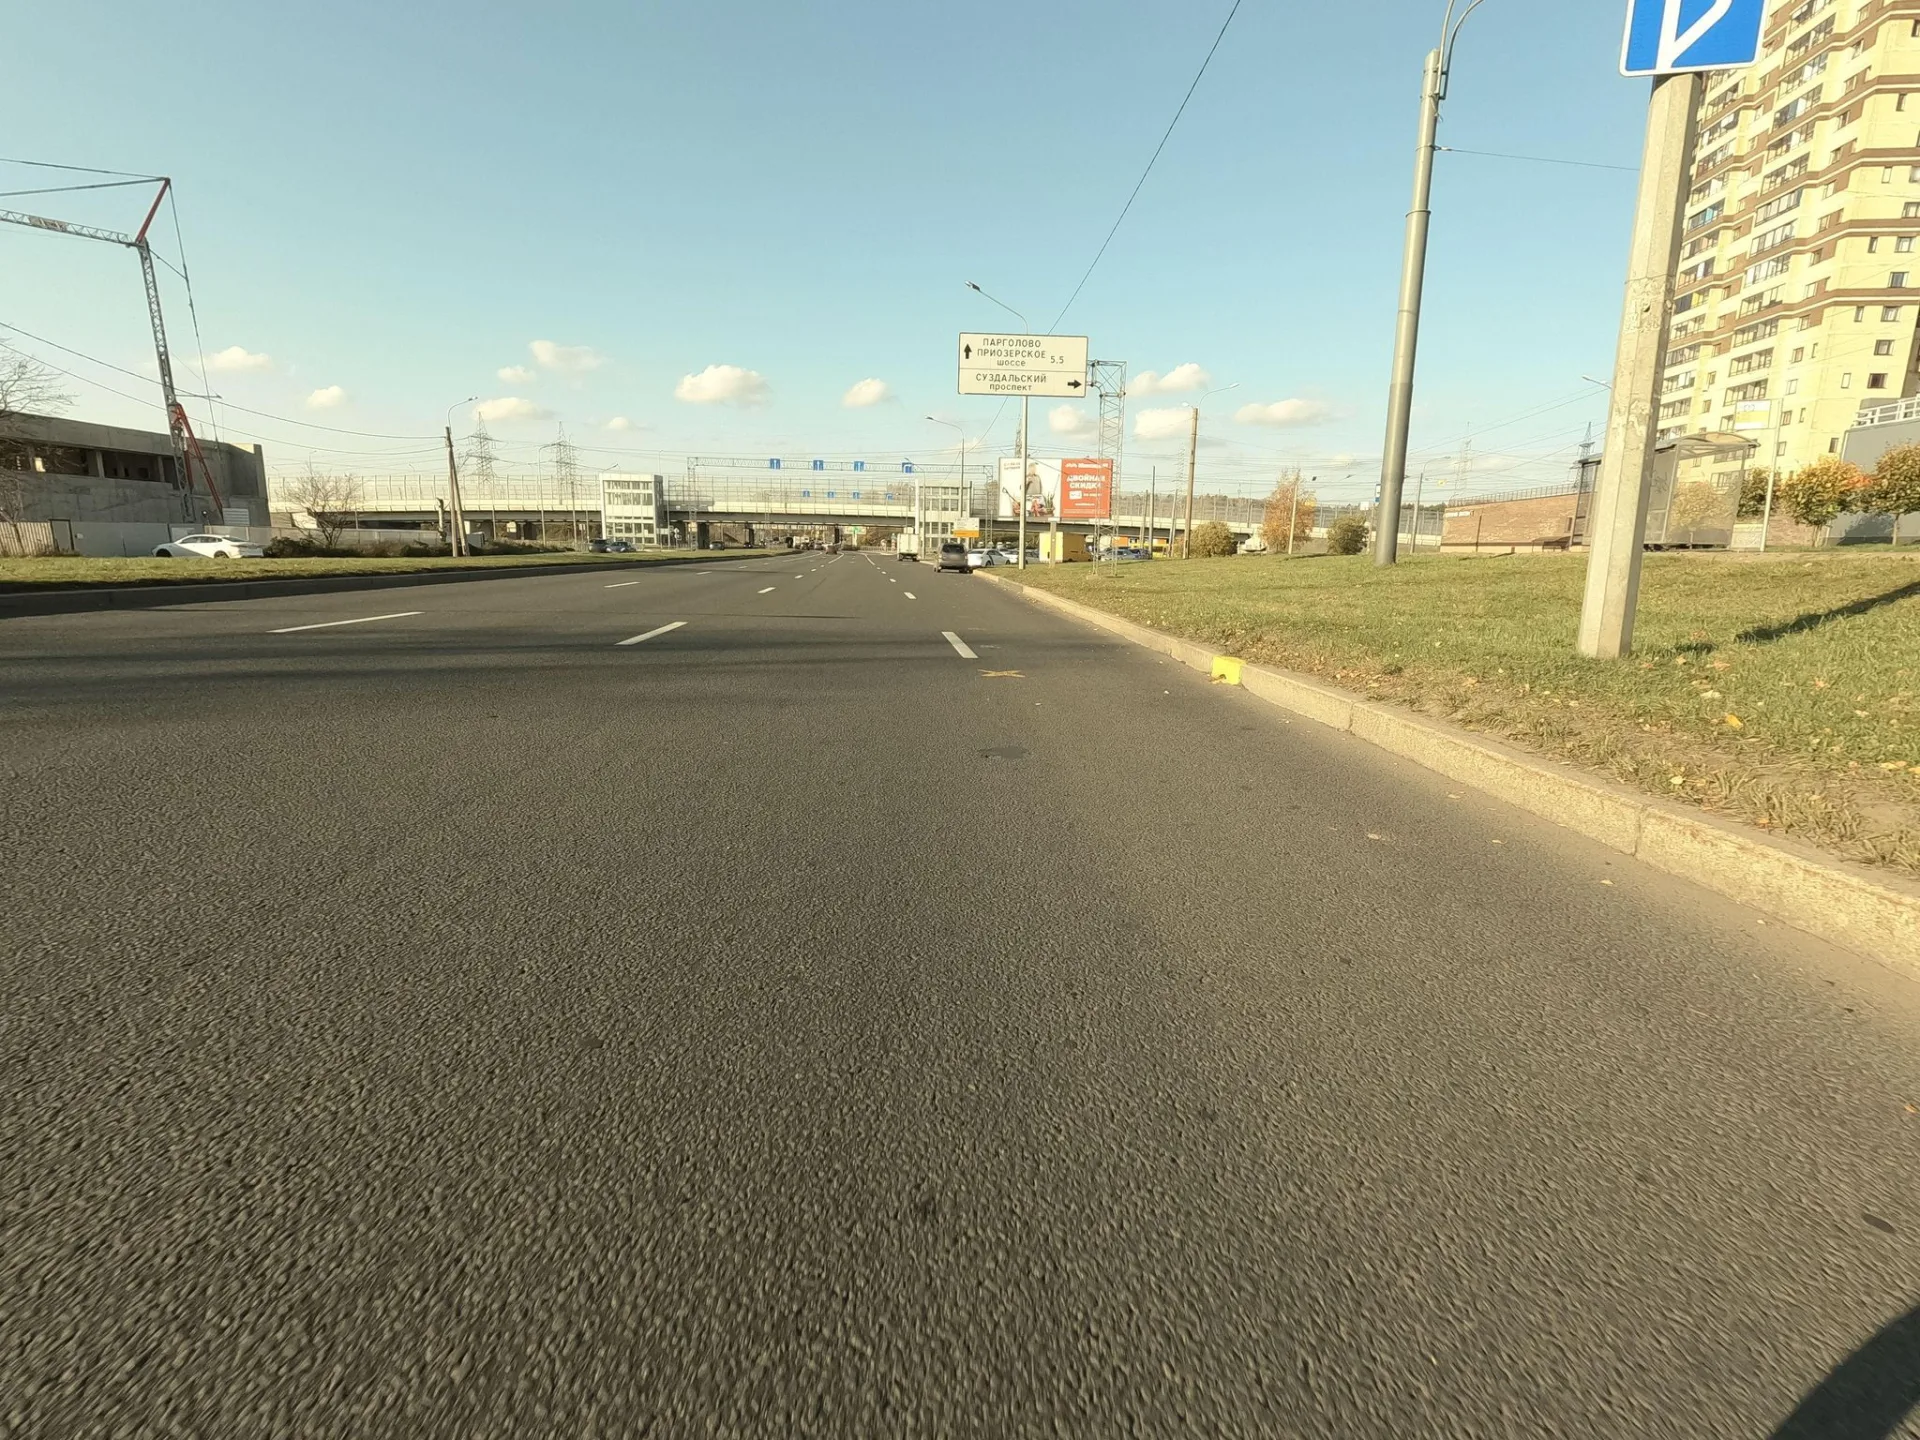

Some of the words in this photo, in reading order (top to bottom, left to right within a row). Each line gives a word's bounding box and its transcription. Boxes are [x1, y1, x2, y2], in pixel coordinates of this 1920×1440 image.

[982, 338, 1041, 348] ПАРГОЛОВО
[977, 348, 1046, 359] ПРИОЗЕРСКОЕ
[1050, 356, 1064, 364] 5.5
[975, 373, 1047, 383] СУЗДАЛЬСКИЙ
[989, 383, 1032, 392] проспект
